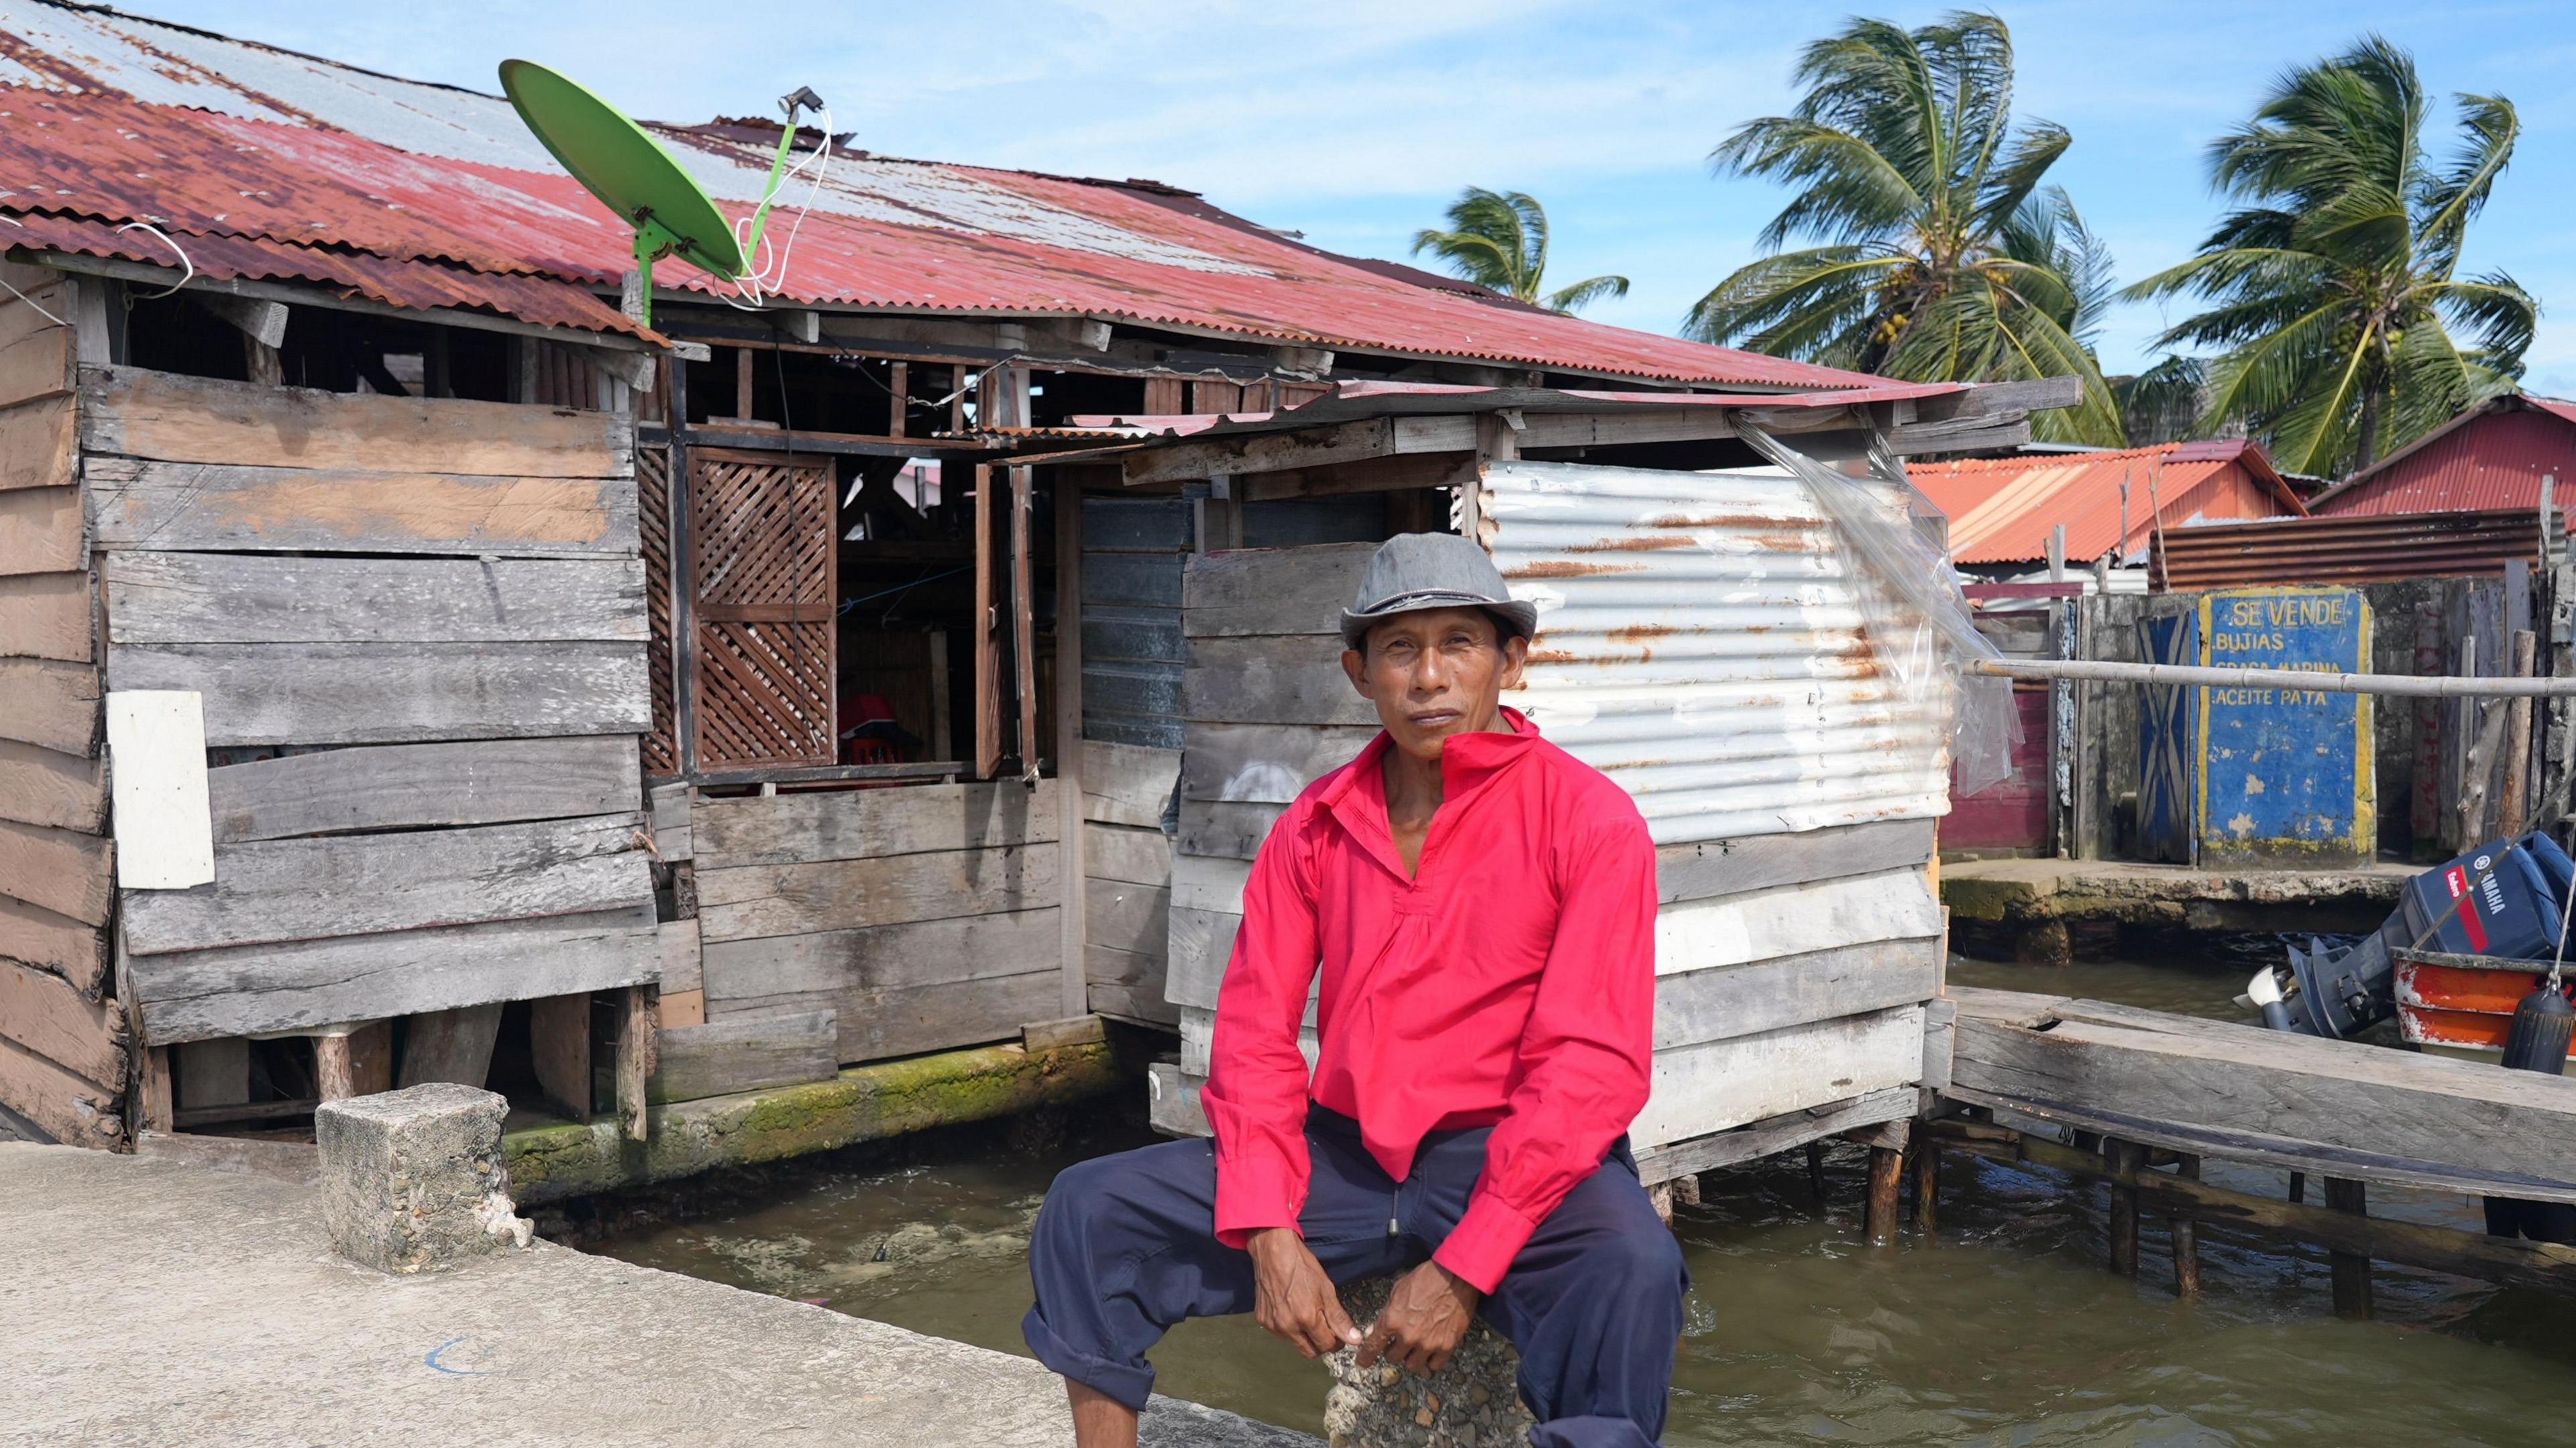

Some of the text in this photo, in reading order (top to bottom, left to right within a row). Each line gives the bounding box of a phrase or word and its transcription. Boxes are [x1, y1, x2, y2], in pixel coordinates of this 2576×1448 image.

[2233, 598, 2345, 627] SE VENDE
[2216, 632, 2284, 651] BUJIAS
[2215, 689, 2327, 706] ACEITE PATA
